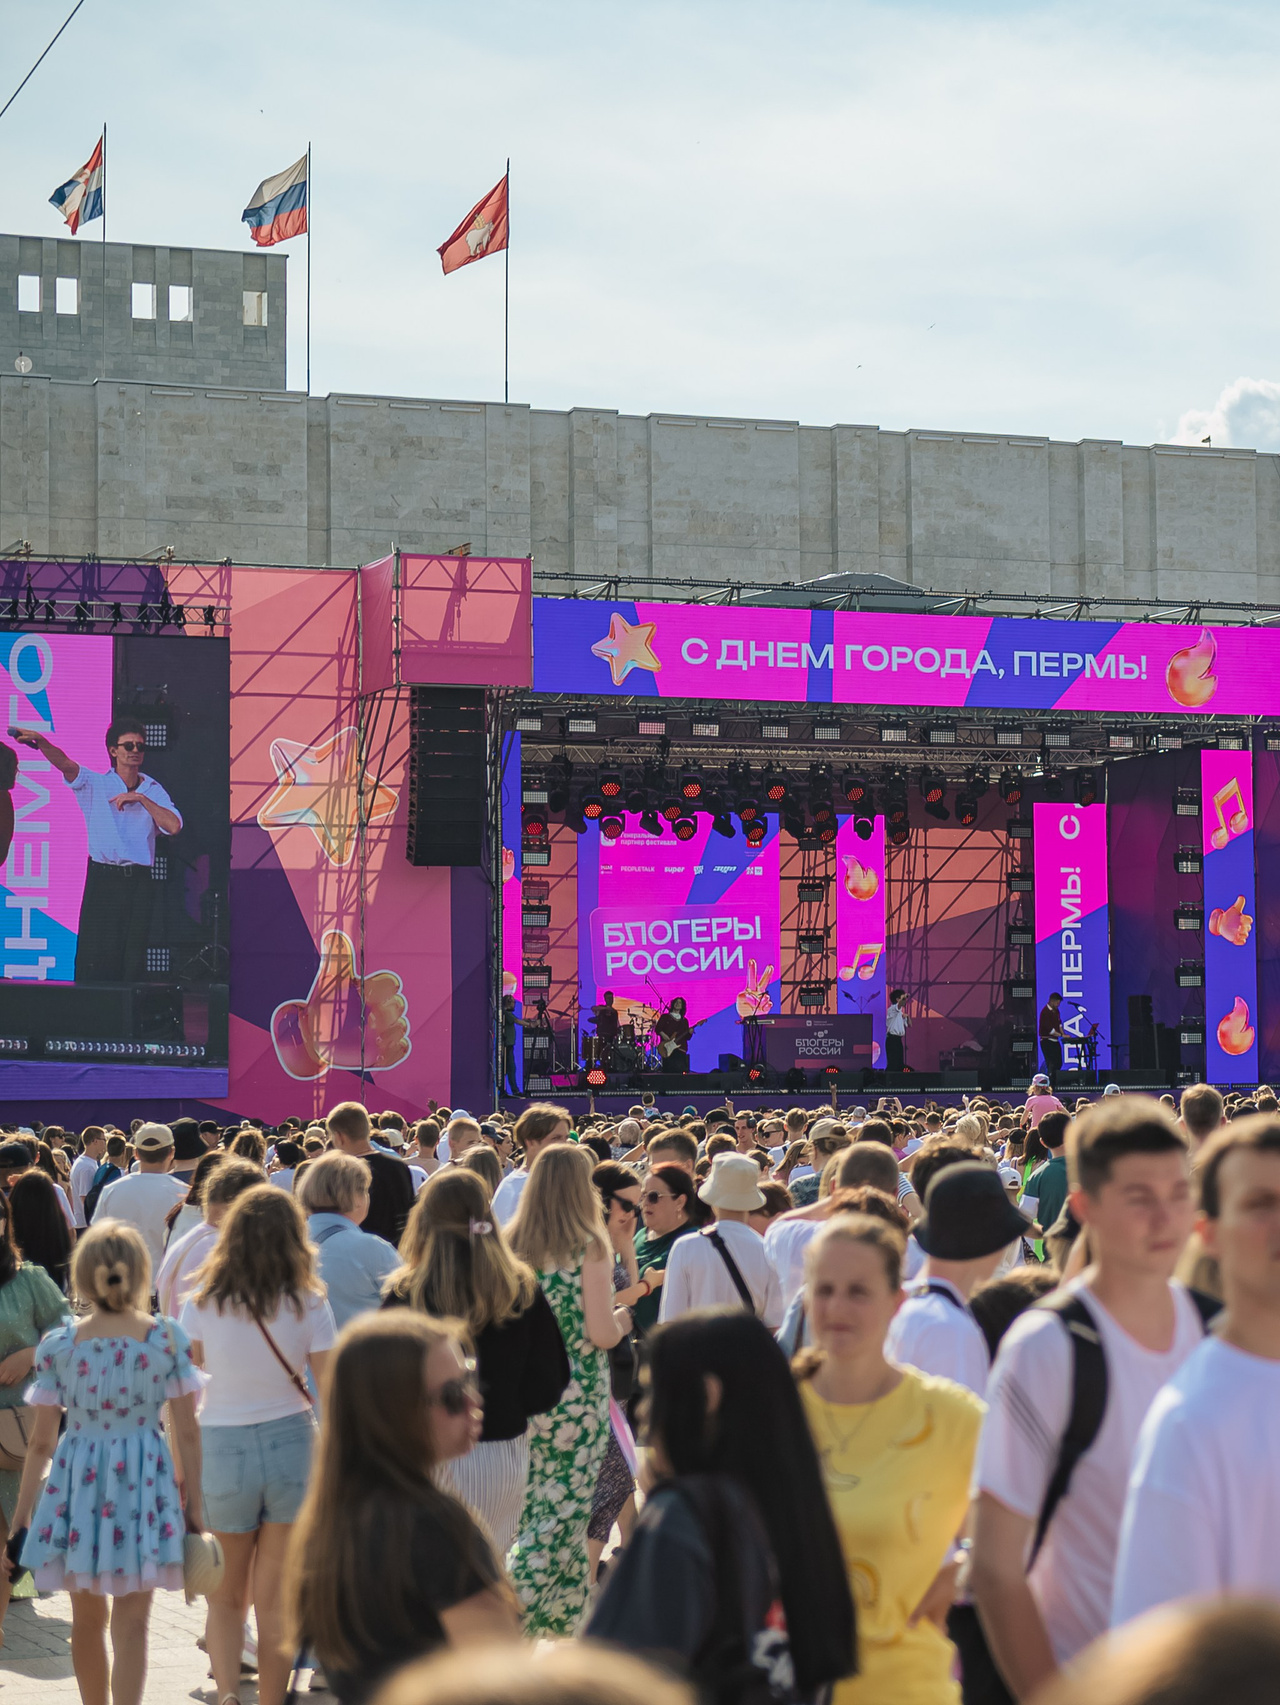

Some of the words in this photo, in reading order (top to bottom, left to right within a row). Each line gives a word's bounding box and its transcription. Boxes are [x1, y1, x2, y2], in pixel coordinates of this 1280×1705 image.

[680, 637, 710, 666] С
[716, 638, 835, 672] ДНЕМ
[845, 643, 1005, 680] ГОРОДА,
[1012, 650, 1148, 681] ПЕРМЬ!
[8, 632, 54, 733] ГО
[1058, 814, 1081, 840] С
[602, 915, 762, 948] БЛОГЕРЫ
[1059, 866, 1084, 998] ПЕРМЬ!
[605, 945, 744, 977] РОССИИ
[795, 1038, 844, 1047] БЛОГЕРЫ
[798, 1047, 841, 1055] РОССИИ
[1062, 1005, 1087, 1072] ДА,
